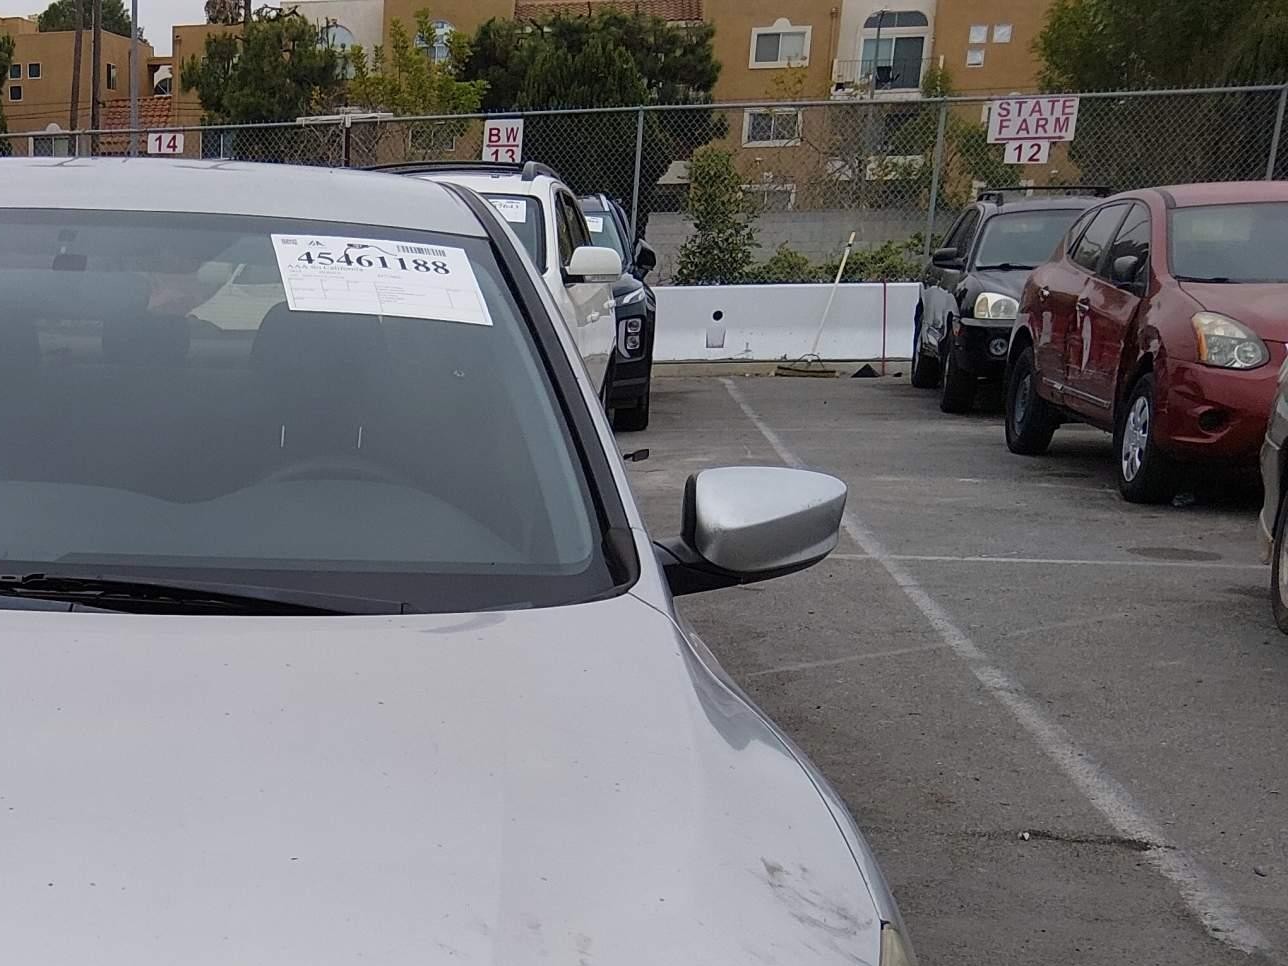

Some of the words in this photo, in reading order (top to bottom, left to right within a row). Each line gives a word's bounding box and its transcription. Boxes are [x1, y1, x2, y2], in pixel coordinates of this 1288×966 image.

[997, 99, 1075, 118] STATE
[488, 126, 520, 144] BW
[998, 117, 1070, 135] FARM
[154, 134, 178, 153] 14
[1013, 142, 1042, 162] 12
[490, 148, 516, 163] 13
[297, 250, 450, 276] 45461188
